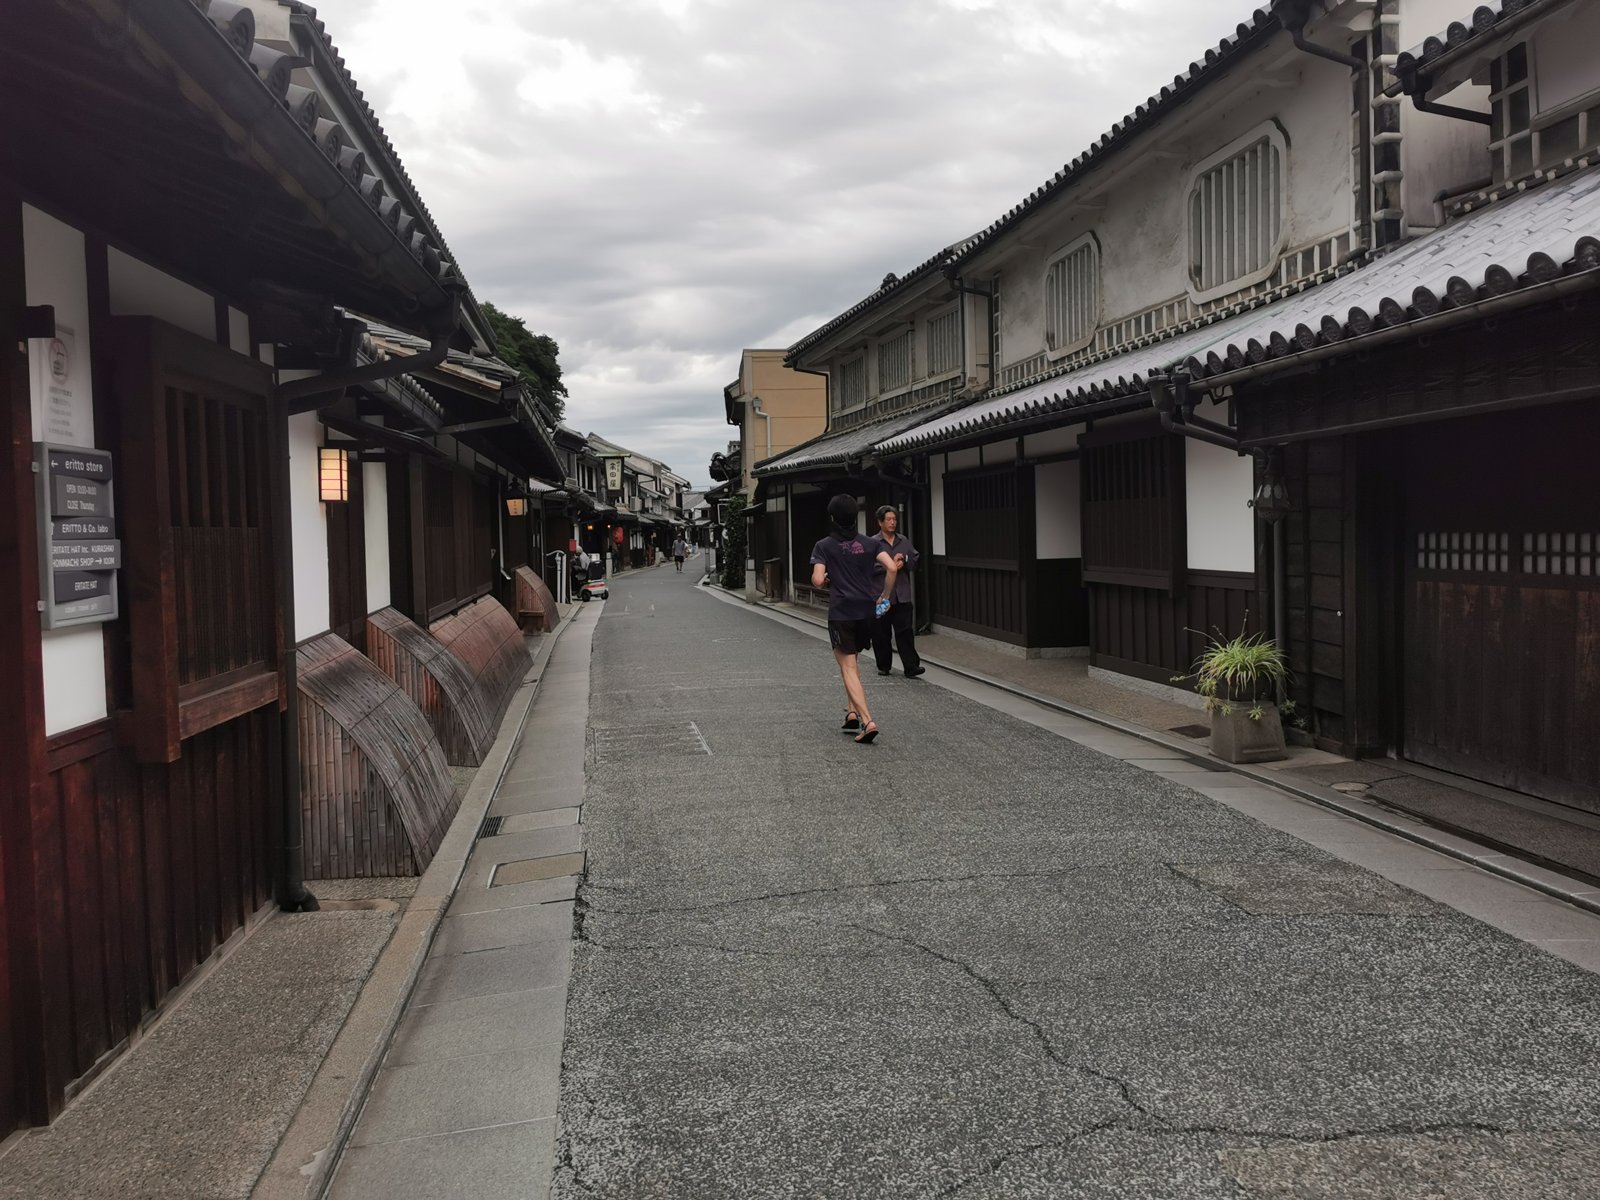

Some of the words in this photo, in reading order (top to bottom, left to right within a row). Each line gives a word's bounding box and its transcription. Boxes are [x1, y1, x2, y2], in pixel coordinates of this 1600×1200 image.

[65, 459, 85, 471] eritto
[86, 461, 104, 472] store
[62, 523, 81, 534] ERITTO
[82, 523, 87, 534] &
[97, 524, 109, 534] labo
[71, 545, 80, 554] HAT
[80, 557, 94, 567] SHOP
